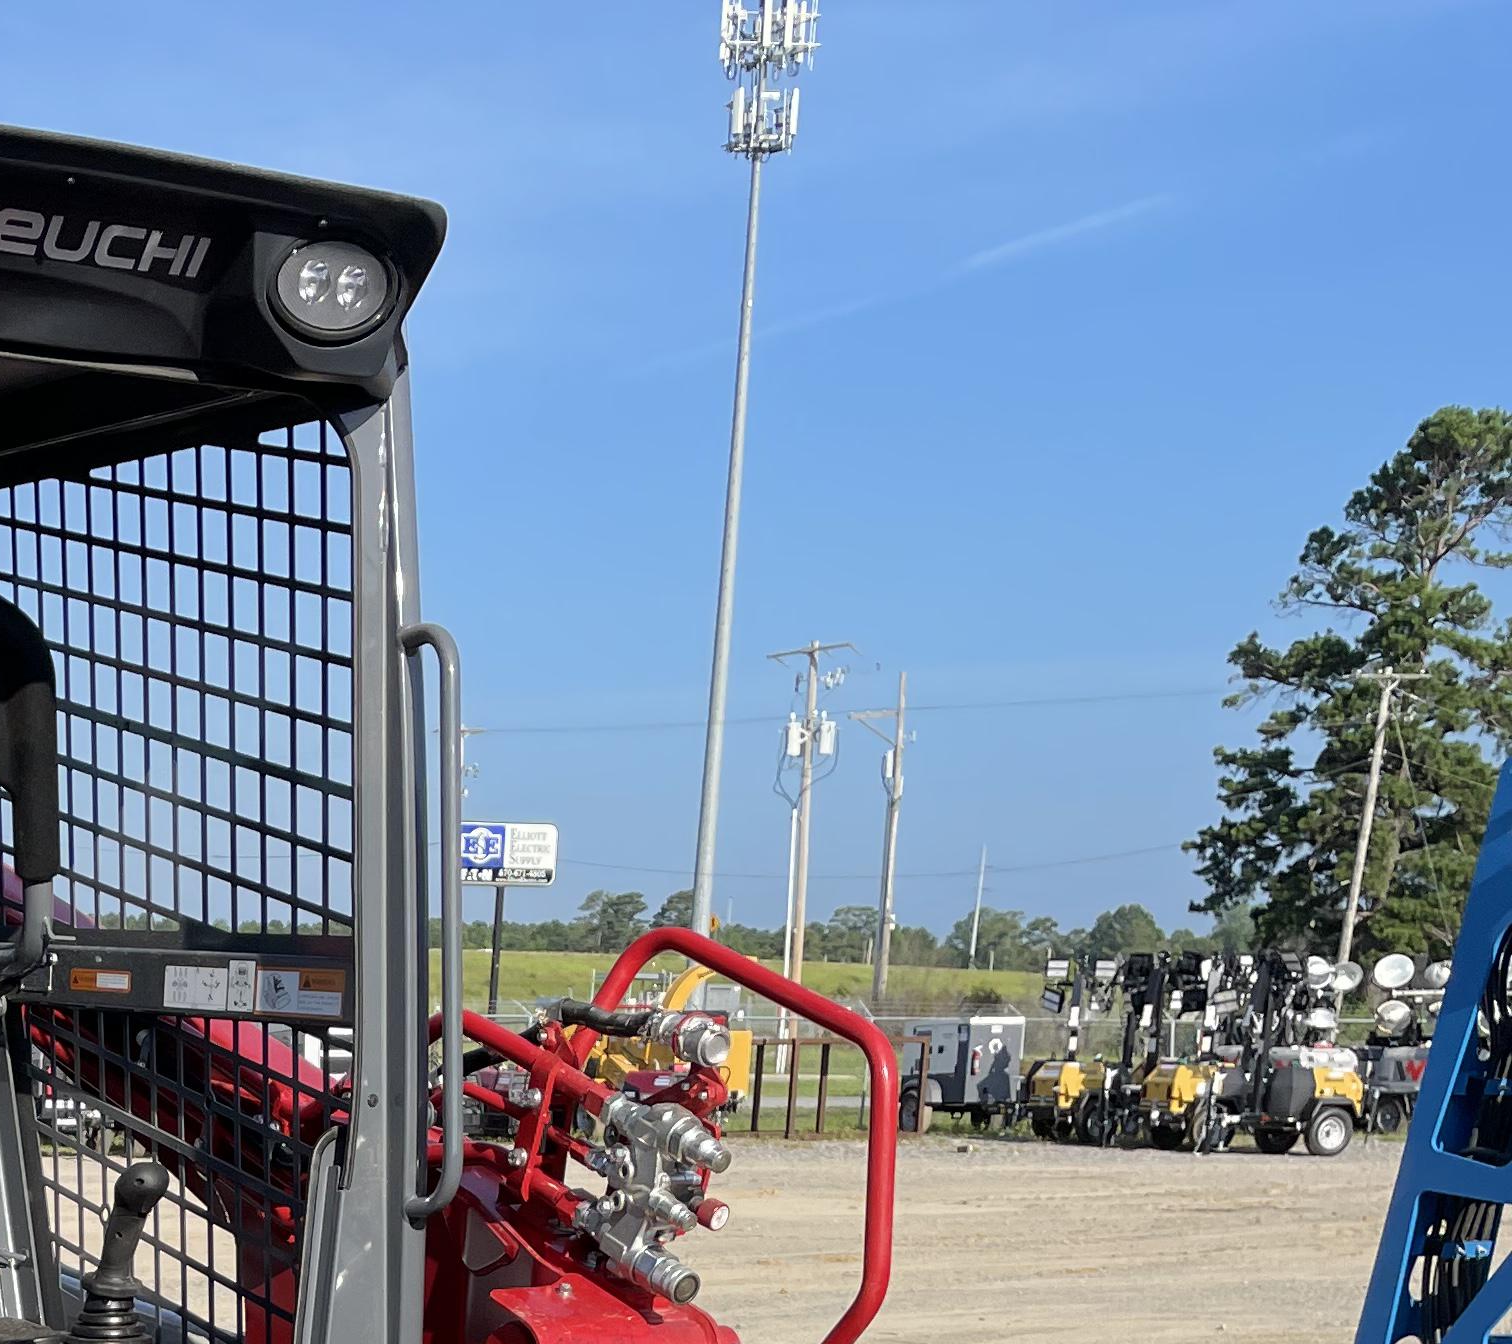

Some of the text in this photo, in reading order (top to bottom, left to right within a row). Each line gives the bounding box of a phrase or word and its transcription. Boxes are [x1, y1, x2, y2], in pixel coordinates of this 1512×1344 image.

[510, 828, 548, 841] ELLIOTT
[510, 840, 550, 854] ELECTRIC
[508, 853, 542, 865] SUPPLY
